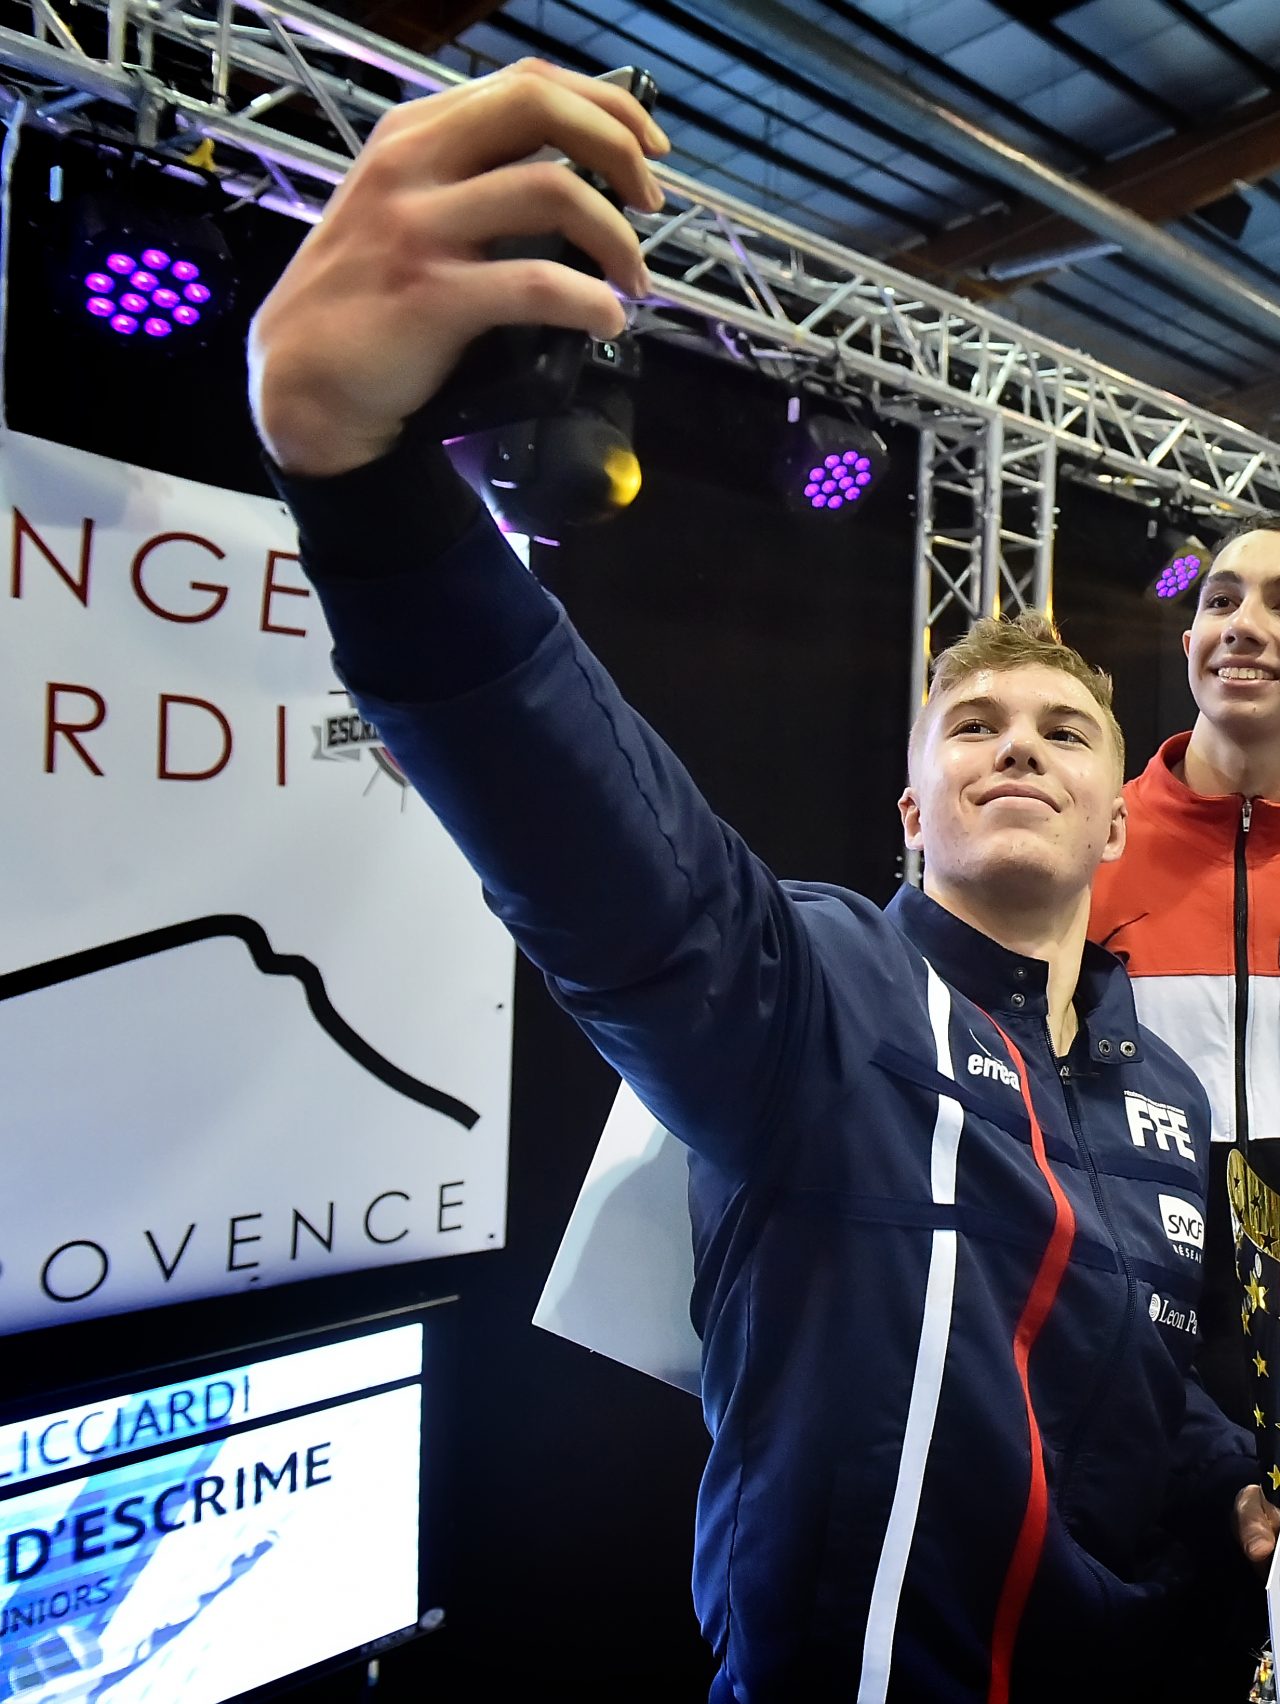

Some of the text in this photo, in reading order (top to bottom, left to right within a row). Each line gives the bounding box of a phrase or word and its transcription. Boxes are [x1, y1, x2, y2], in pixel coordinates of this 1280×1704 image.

[11, 504, 311, 638] NGE
[45, 681, 286, 787] RDI
[1124, 1095, 1196, 1163] FFE
[0, 1181, 466, 1303] OVENCE
[1167, 1214, 1203, 1241] SNCF
[7, 1441, 334, 1583] D'ESCRIME
